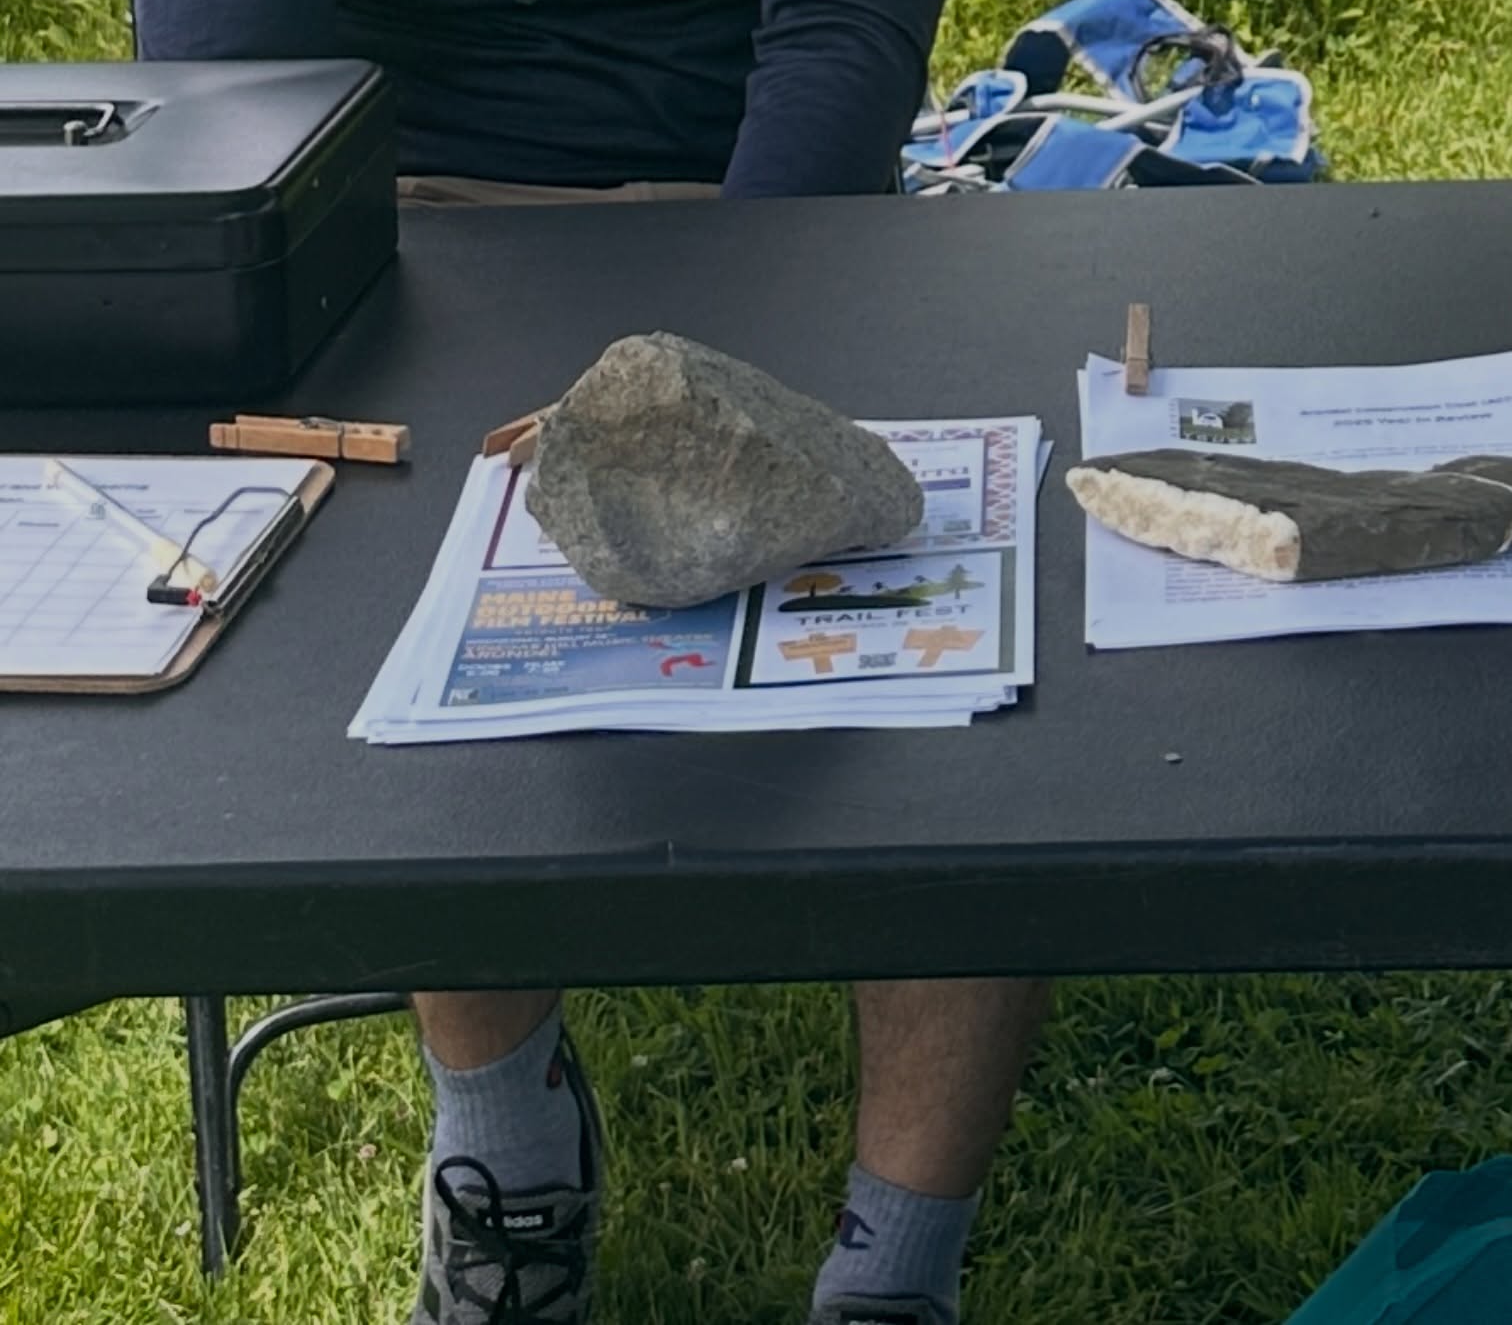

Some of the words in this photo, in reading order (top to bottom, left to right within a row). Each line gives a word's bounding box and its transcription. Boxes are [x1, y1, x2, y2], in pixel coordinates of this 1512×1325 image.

[479, 590, 576, 605] MAINE
[476, 600, 619, 617] OUTDOOR
[794, 612, 882, 626] TRAIL
[896, 605, 972, 619] FEST
[472, 615, 531, 628] FILM
[539, 610, 650, 626] FESTIVAL
